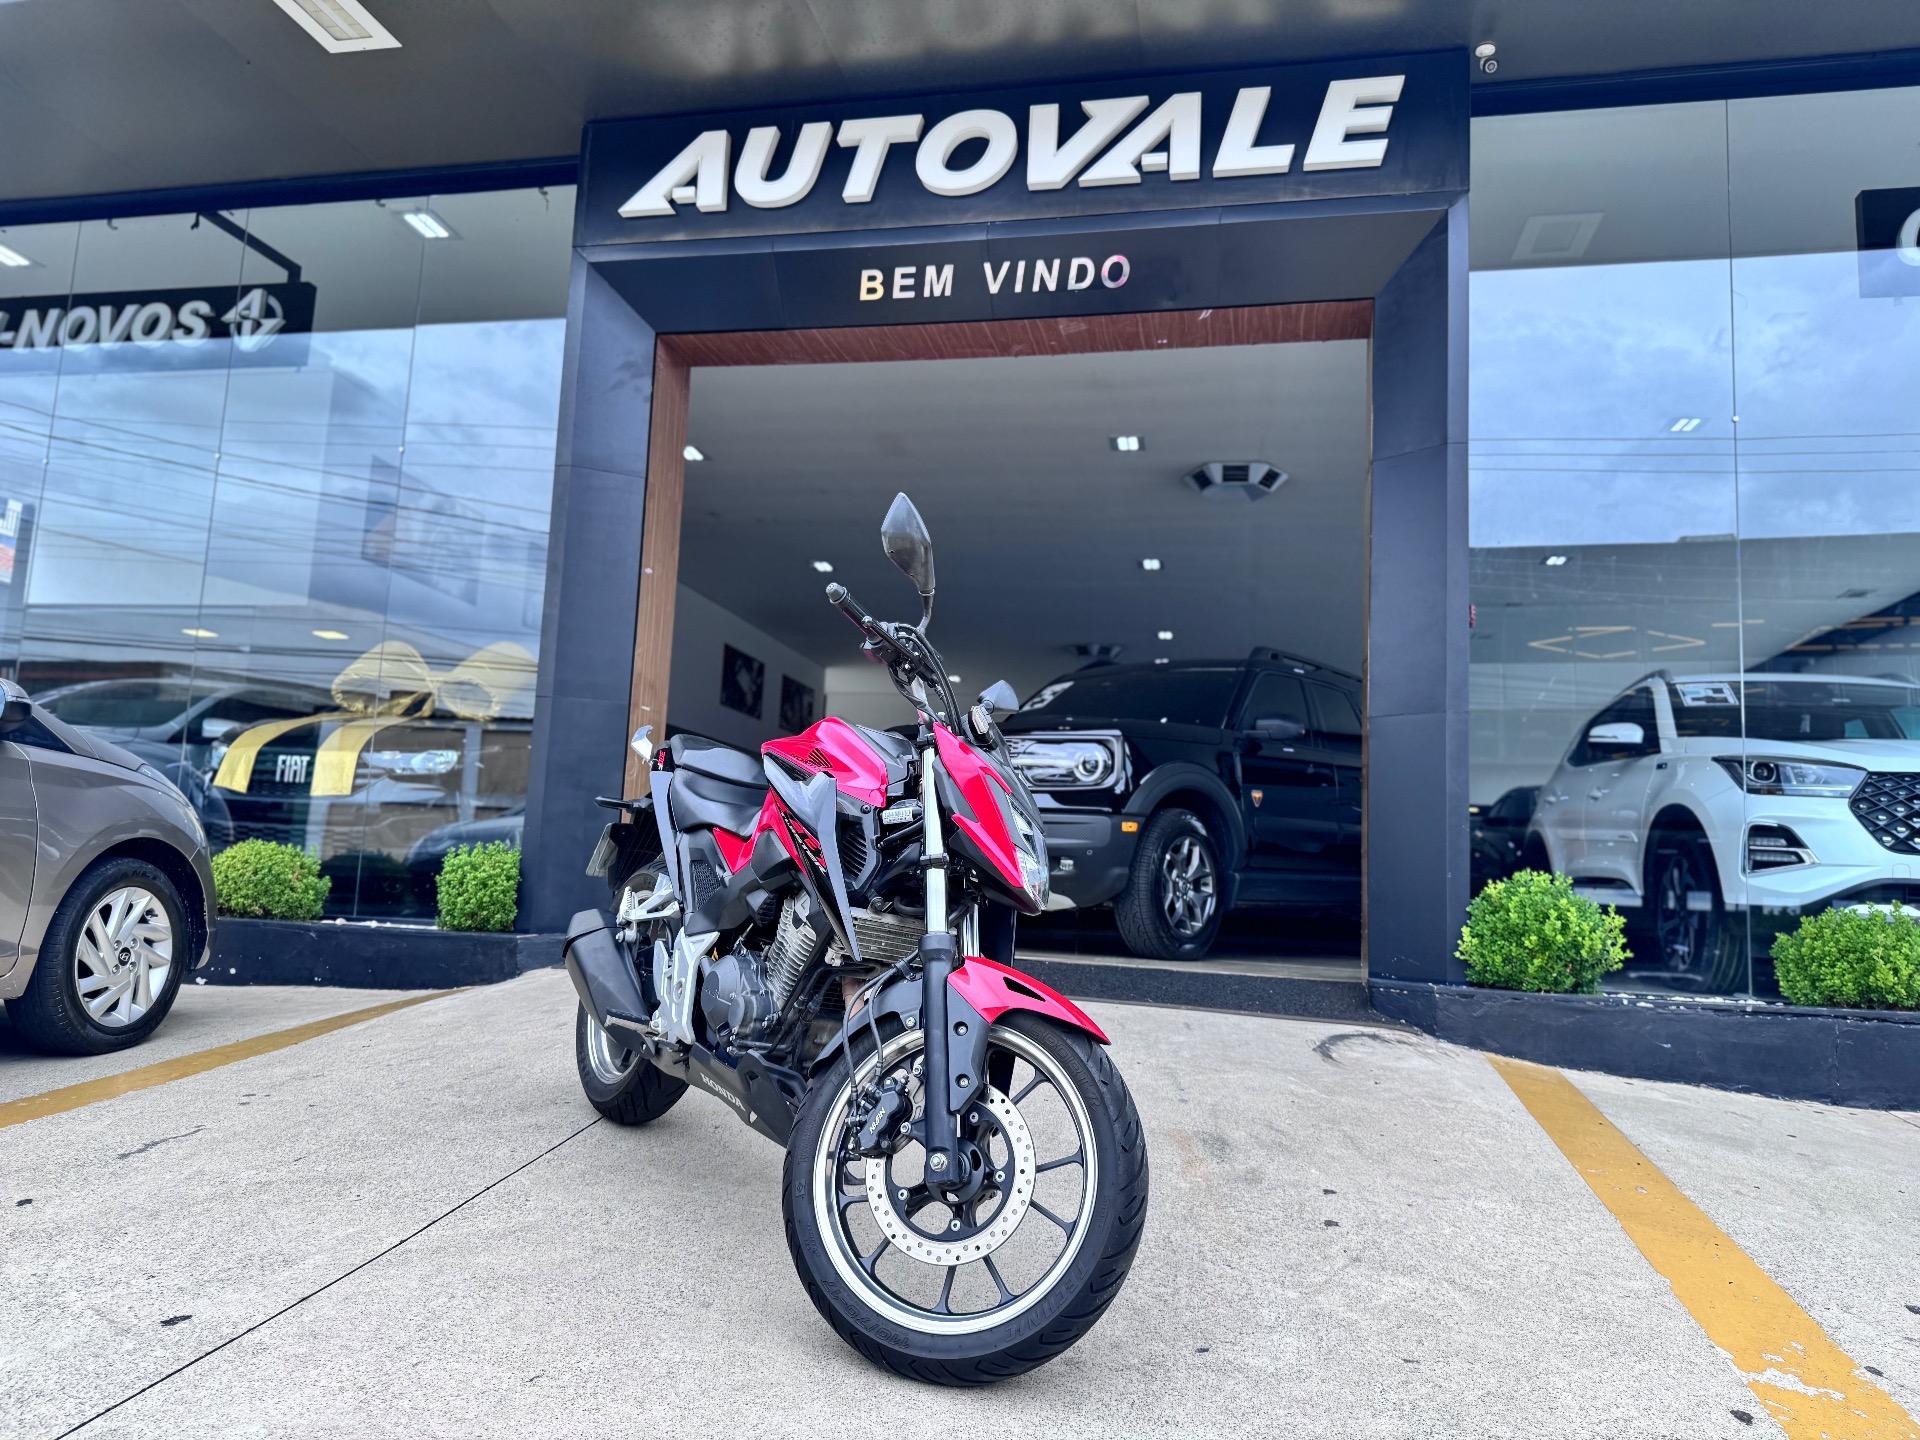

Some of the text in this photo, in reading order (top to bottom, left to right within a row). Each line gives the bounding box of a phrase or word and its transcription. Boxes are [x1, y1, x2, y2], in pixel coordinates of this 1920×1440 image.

[617, 74, 1405, 218] AUTOVALE
[859, 254, 1132, 302] BEM VINDO
[0, 300, 216, 353] -NOVOS
[275, 754, 311, 783] FIAT
[700, 1072, 746, 1111] HONDA
